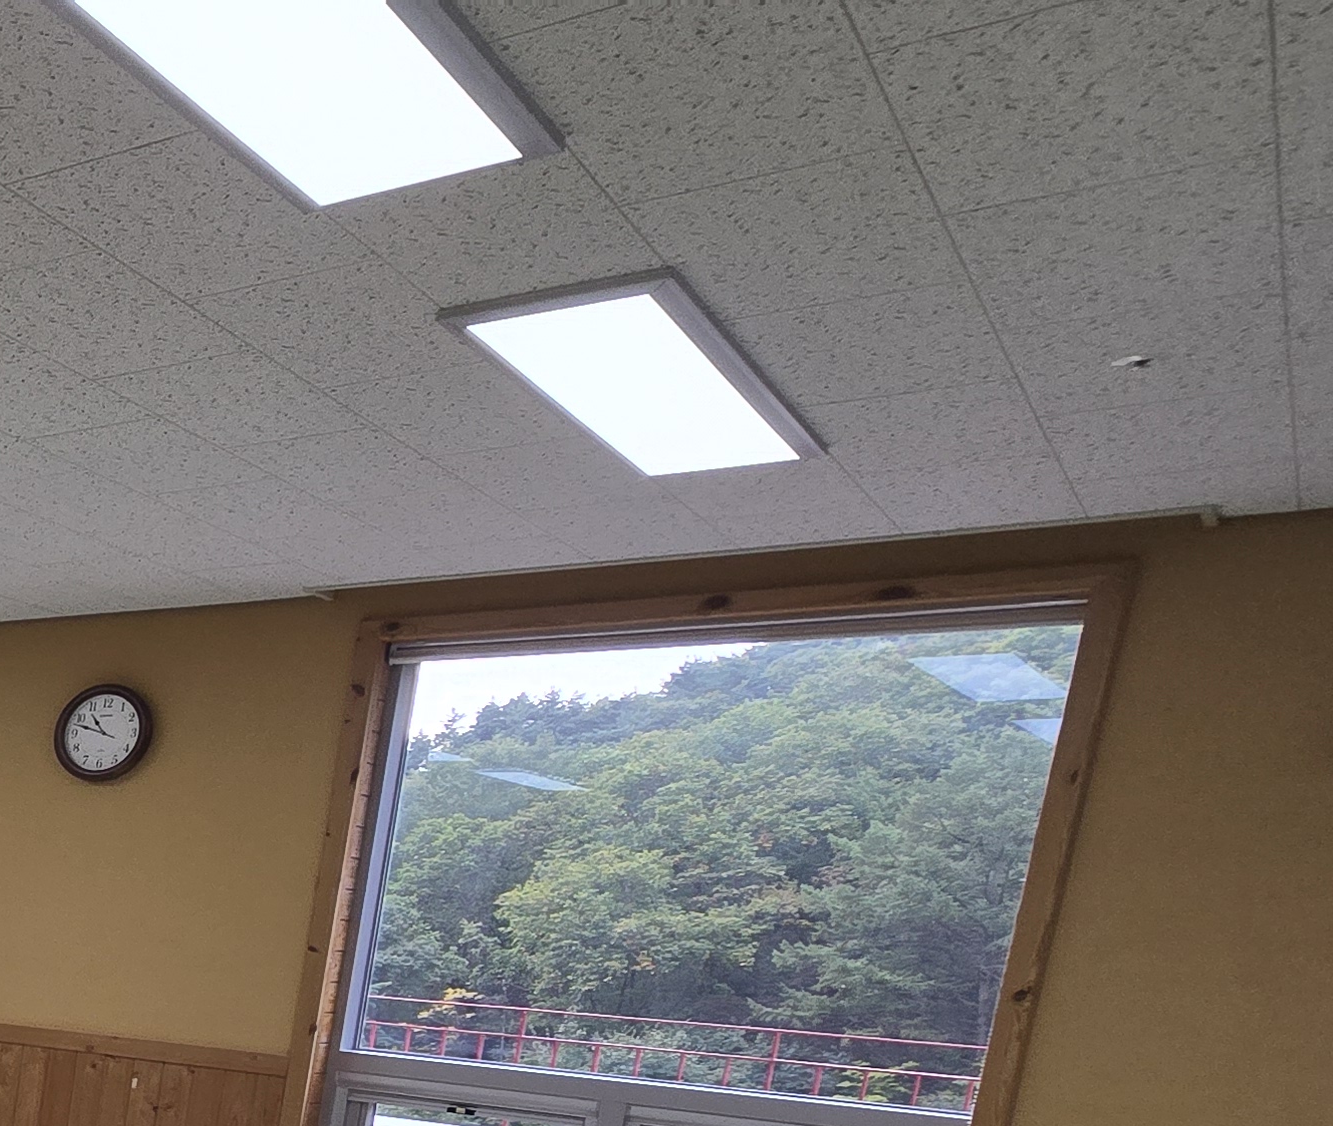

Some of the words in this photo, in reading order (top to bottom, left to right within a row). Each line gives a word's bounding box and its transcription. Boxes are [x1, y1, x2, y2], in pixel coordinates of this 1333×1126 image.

[89, 700, 97, 712] 11
[103, 698, 114, 708] 12
[77, 713, 86, 723] 10
[128, 712, 135, 722] 2
[71, 728, 78, 739] 9
[130, 728, 137, 738] 3
[73, 743, 80, 752] 8
[123, 744, 129, 753] 4
[83, 755, 89, 765] 7
[96, 758, 103, 768] 6
[111, 755, 118, 764] 5
